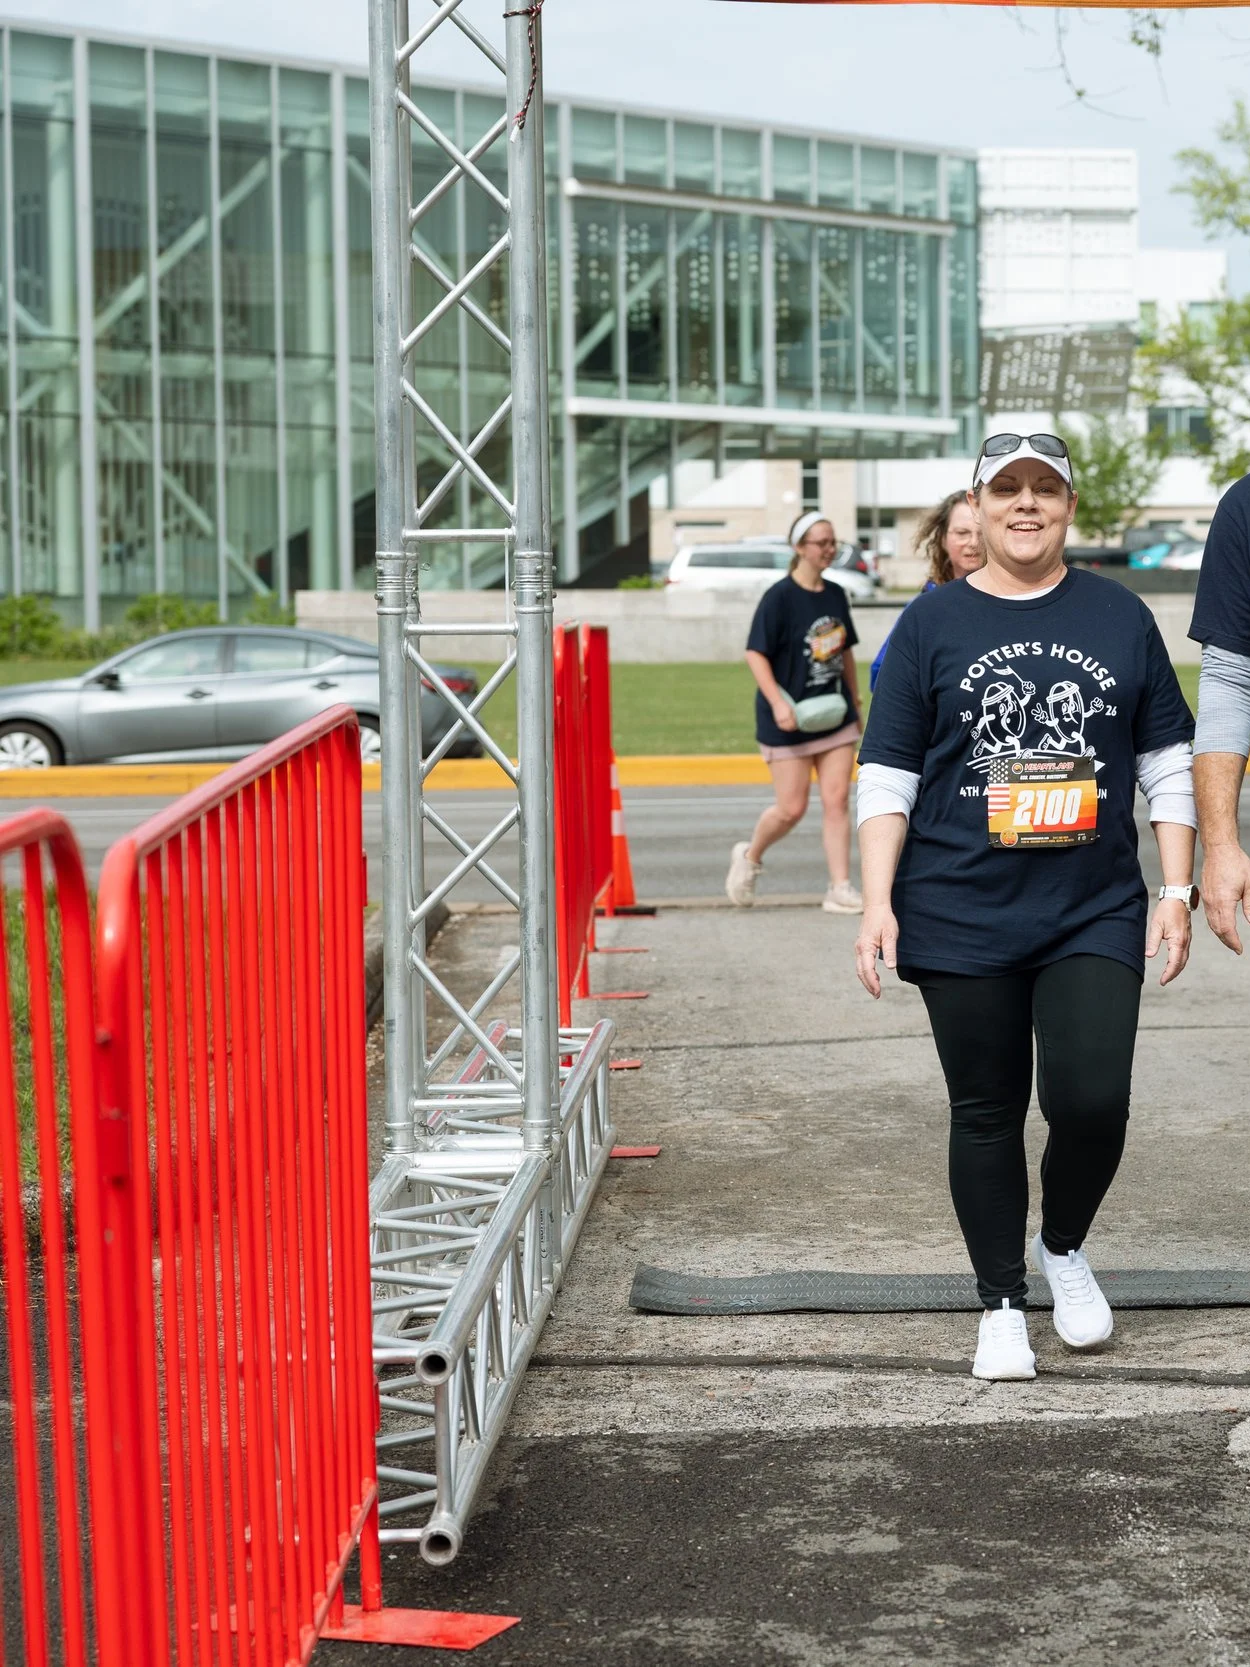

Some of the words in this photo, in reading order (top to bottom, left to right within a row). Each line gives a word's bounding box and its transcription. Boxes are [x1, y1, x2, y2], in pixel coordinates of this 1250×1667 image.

[960, 641, 1043, 692] POTTER'S
[1050, 643, 1117, 692] HOUSE
[960, 710, 973, 723] 20
[1105, 705, 1118, 717] 26
[1024, 761, 1075, 771] HEARTLAND
[959, 786, 980, 798] 4TH
[1012, 788, 1082, 827] 2100
